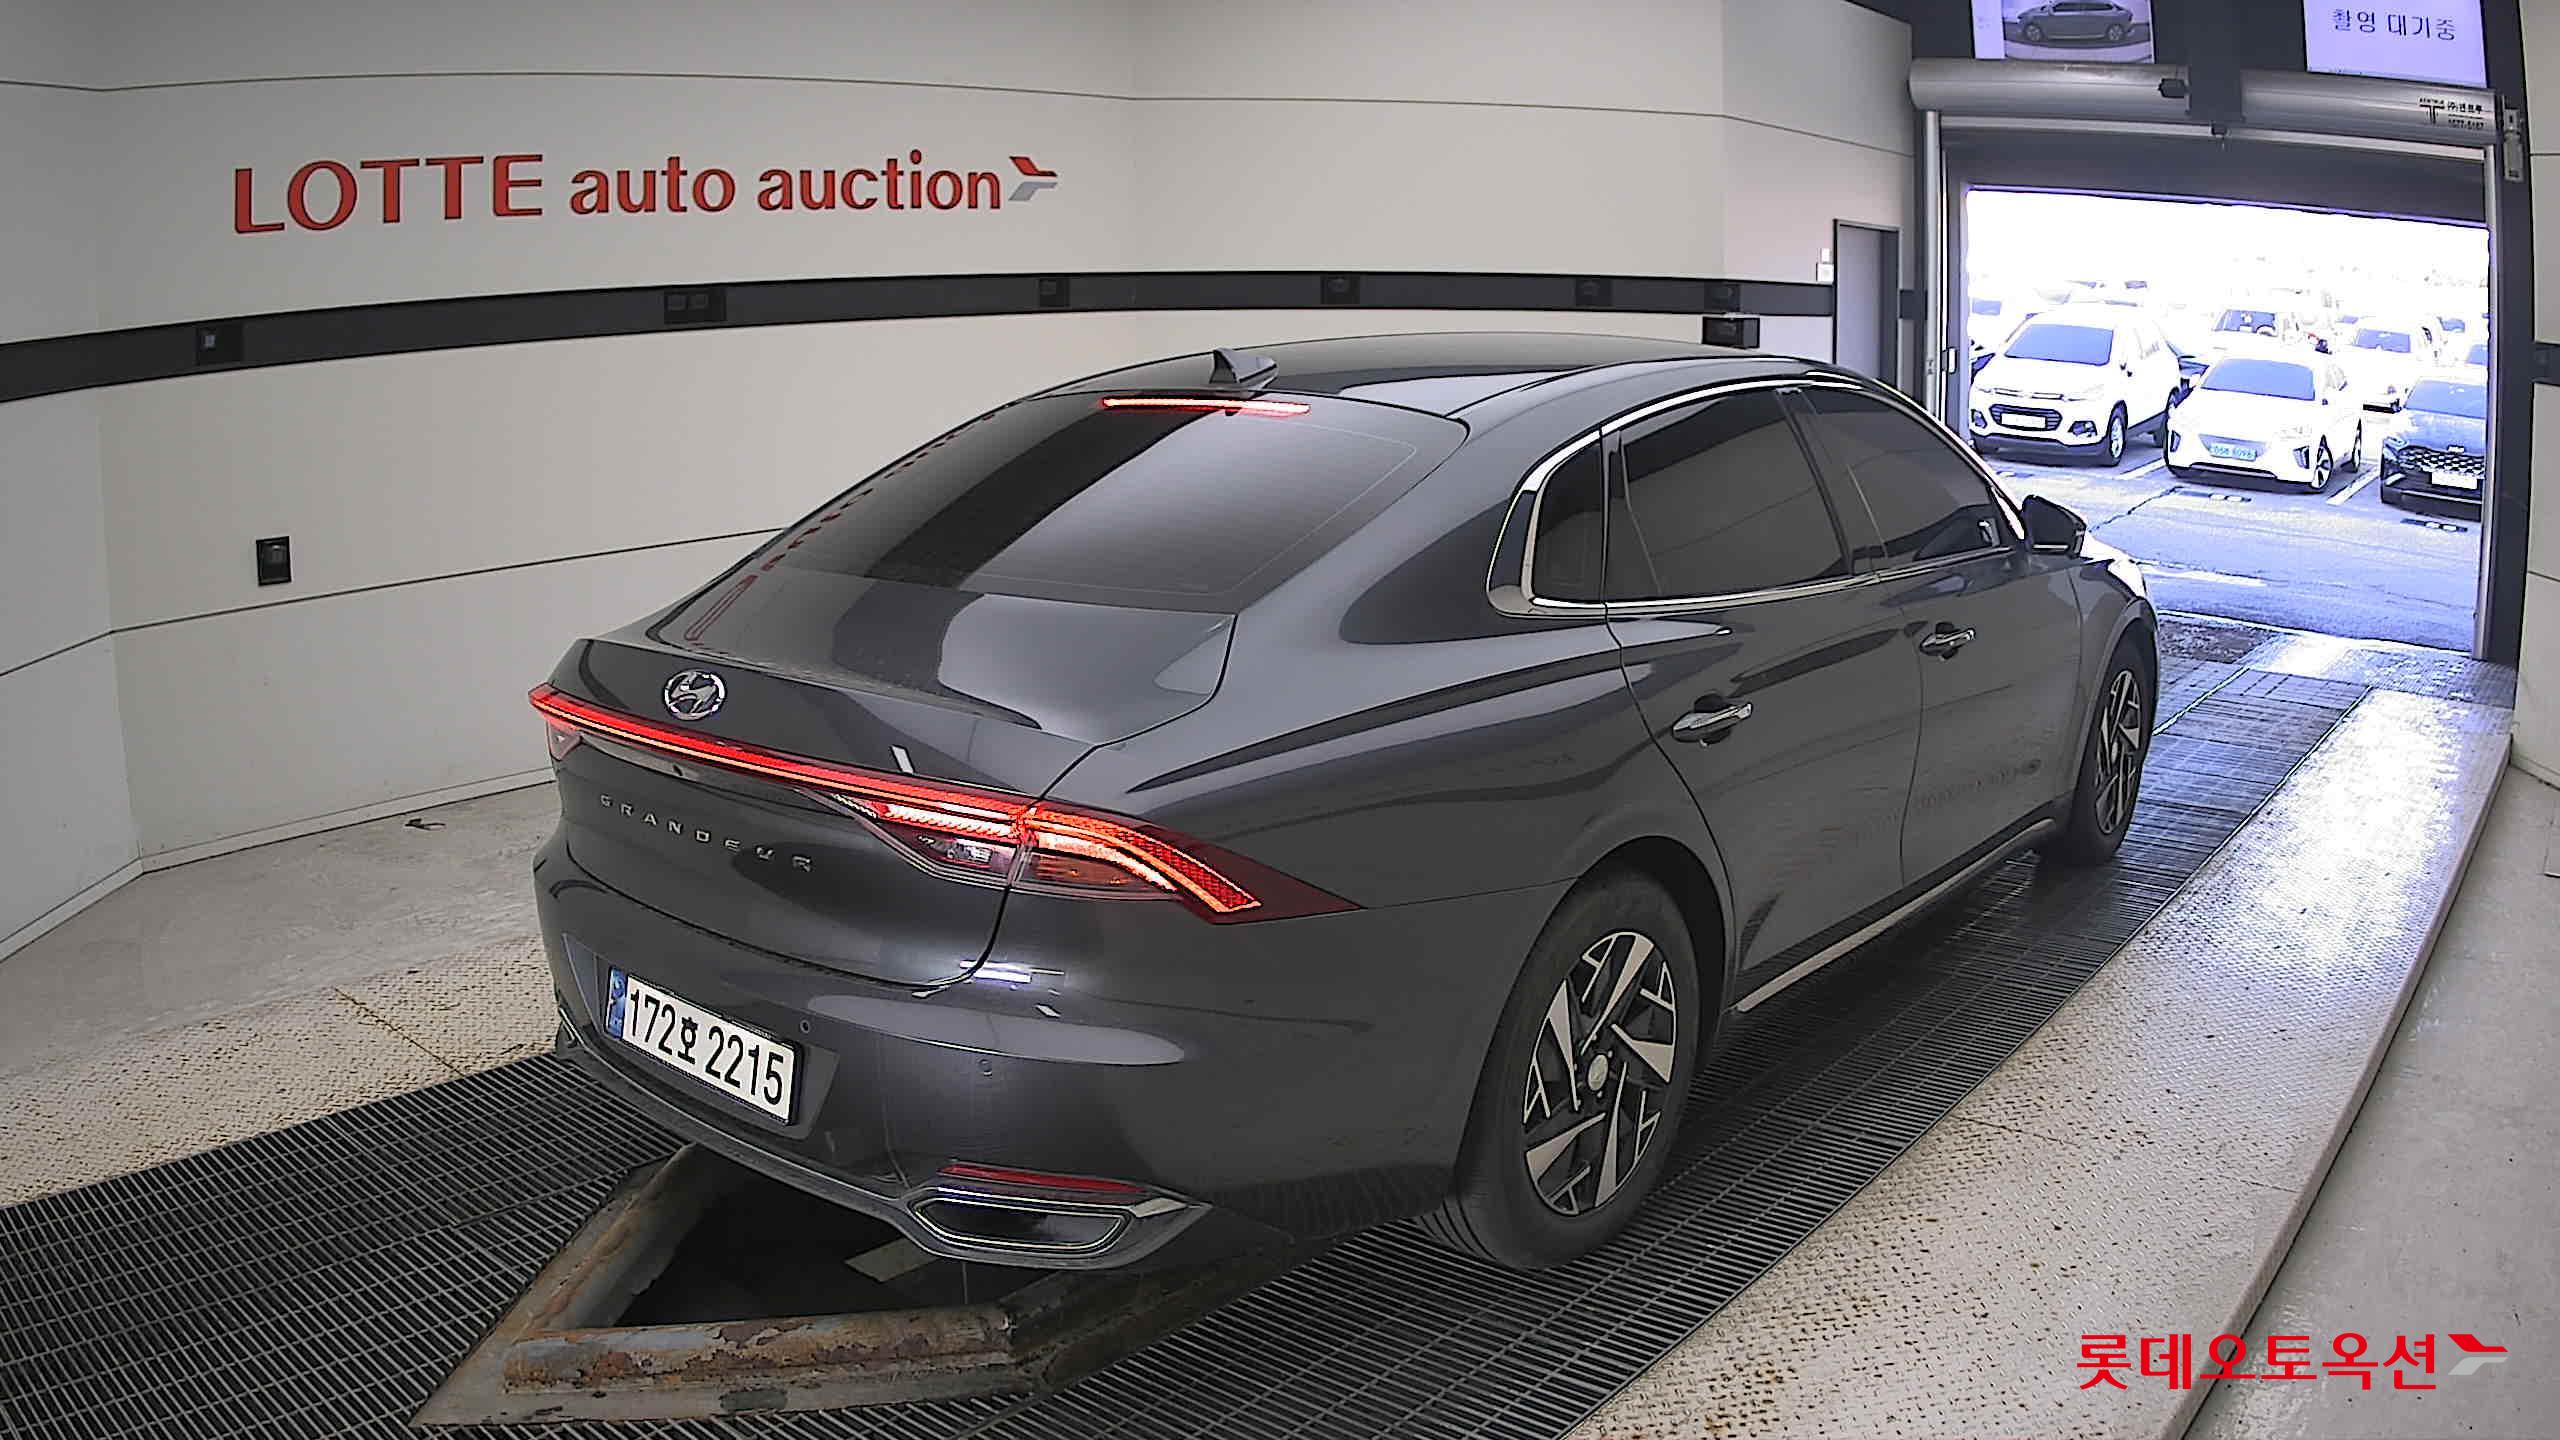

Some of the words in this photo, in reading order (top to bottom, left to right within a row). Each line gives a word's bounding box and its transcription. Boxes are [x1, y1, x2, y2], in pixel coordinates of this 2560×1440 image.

[2332, 8, 2376, 33] 촬영
[234, 153, 543, 233] LOTTE
[568, 155, 736, 215] auto
[757, 149, 1001, 211] auction
[600, 794, 815, 874] GRANDEUR
[629, 987, 697, 1065] 172호
[705, 1025, 785, 1106] 2215
